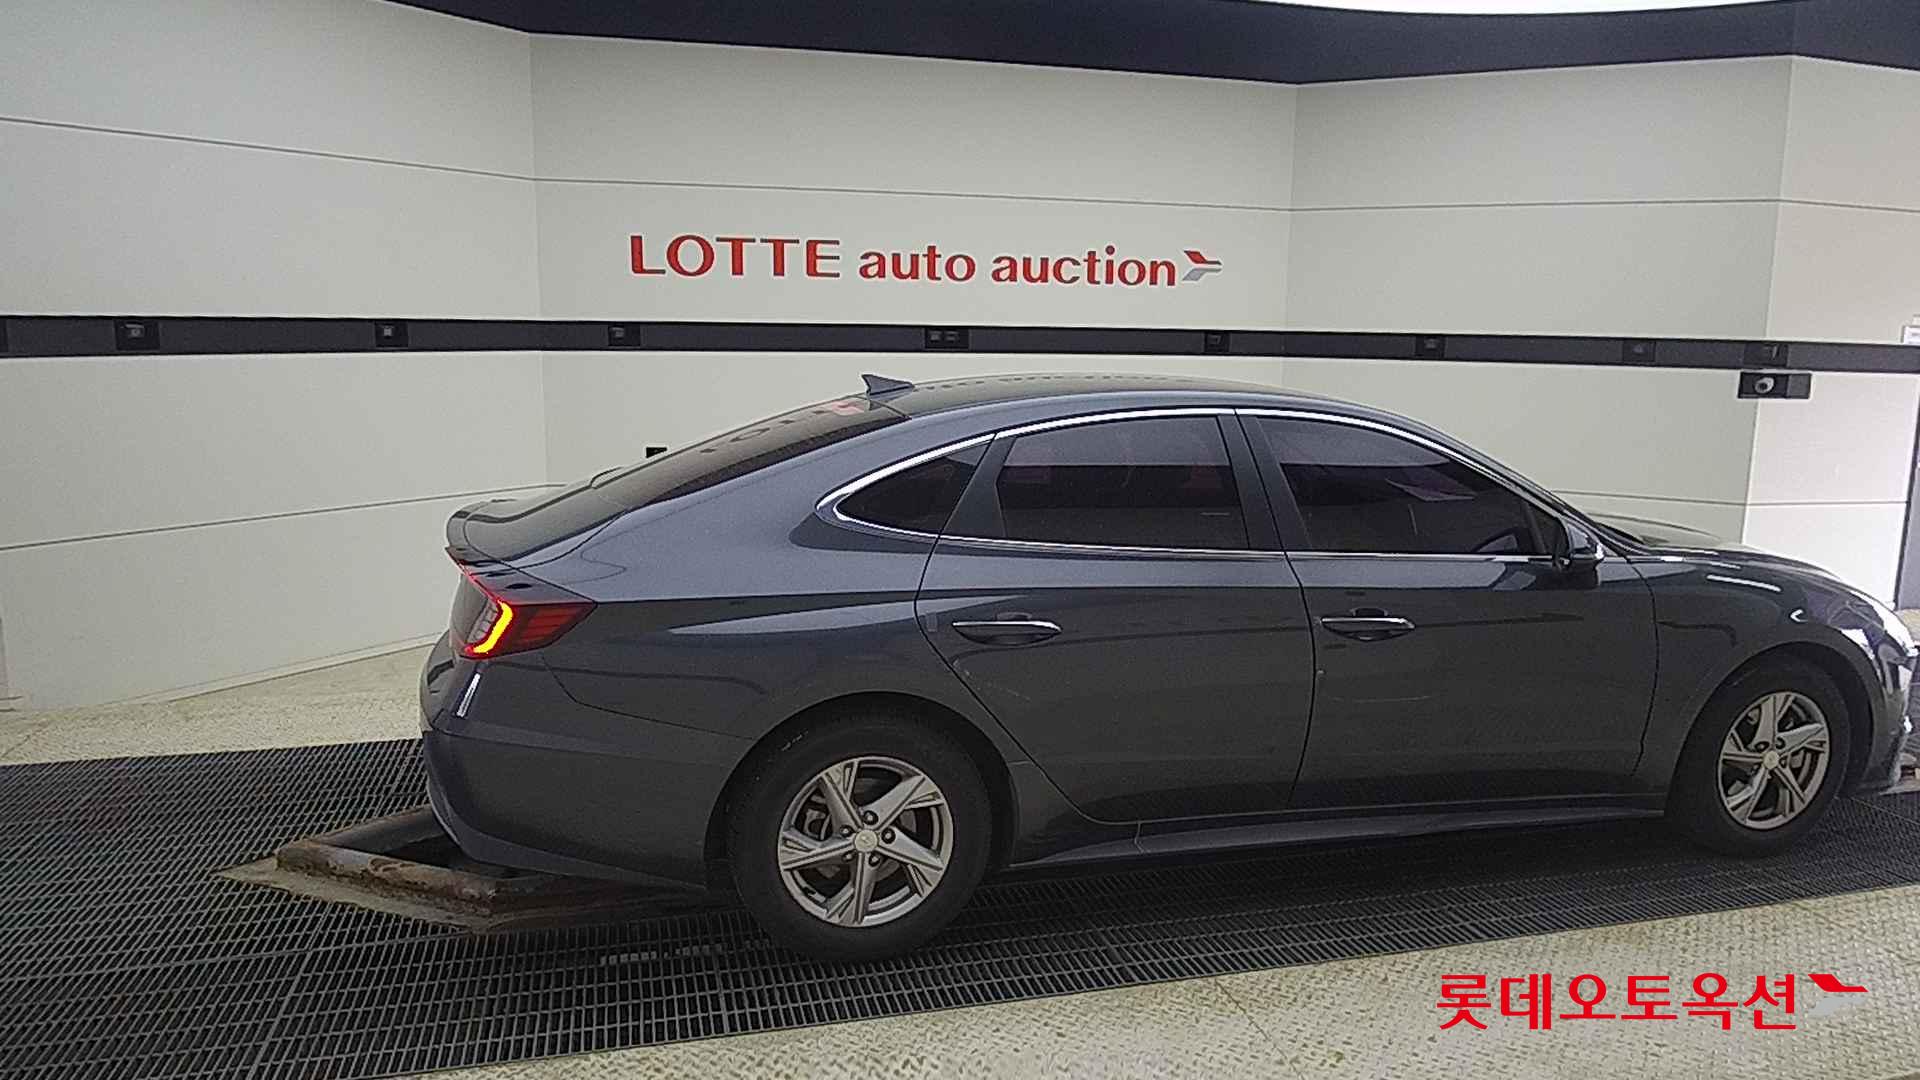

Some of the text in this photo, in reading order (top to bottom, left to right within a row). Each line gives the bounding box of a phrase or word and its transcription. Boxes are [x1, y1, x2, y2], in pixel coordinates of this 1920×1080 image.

[630, 234, 1177, 287] LOTTE auto auction
